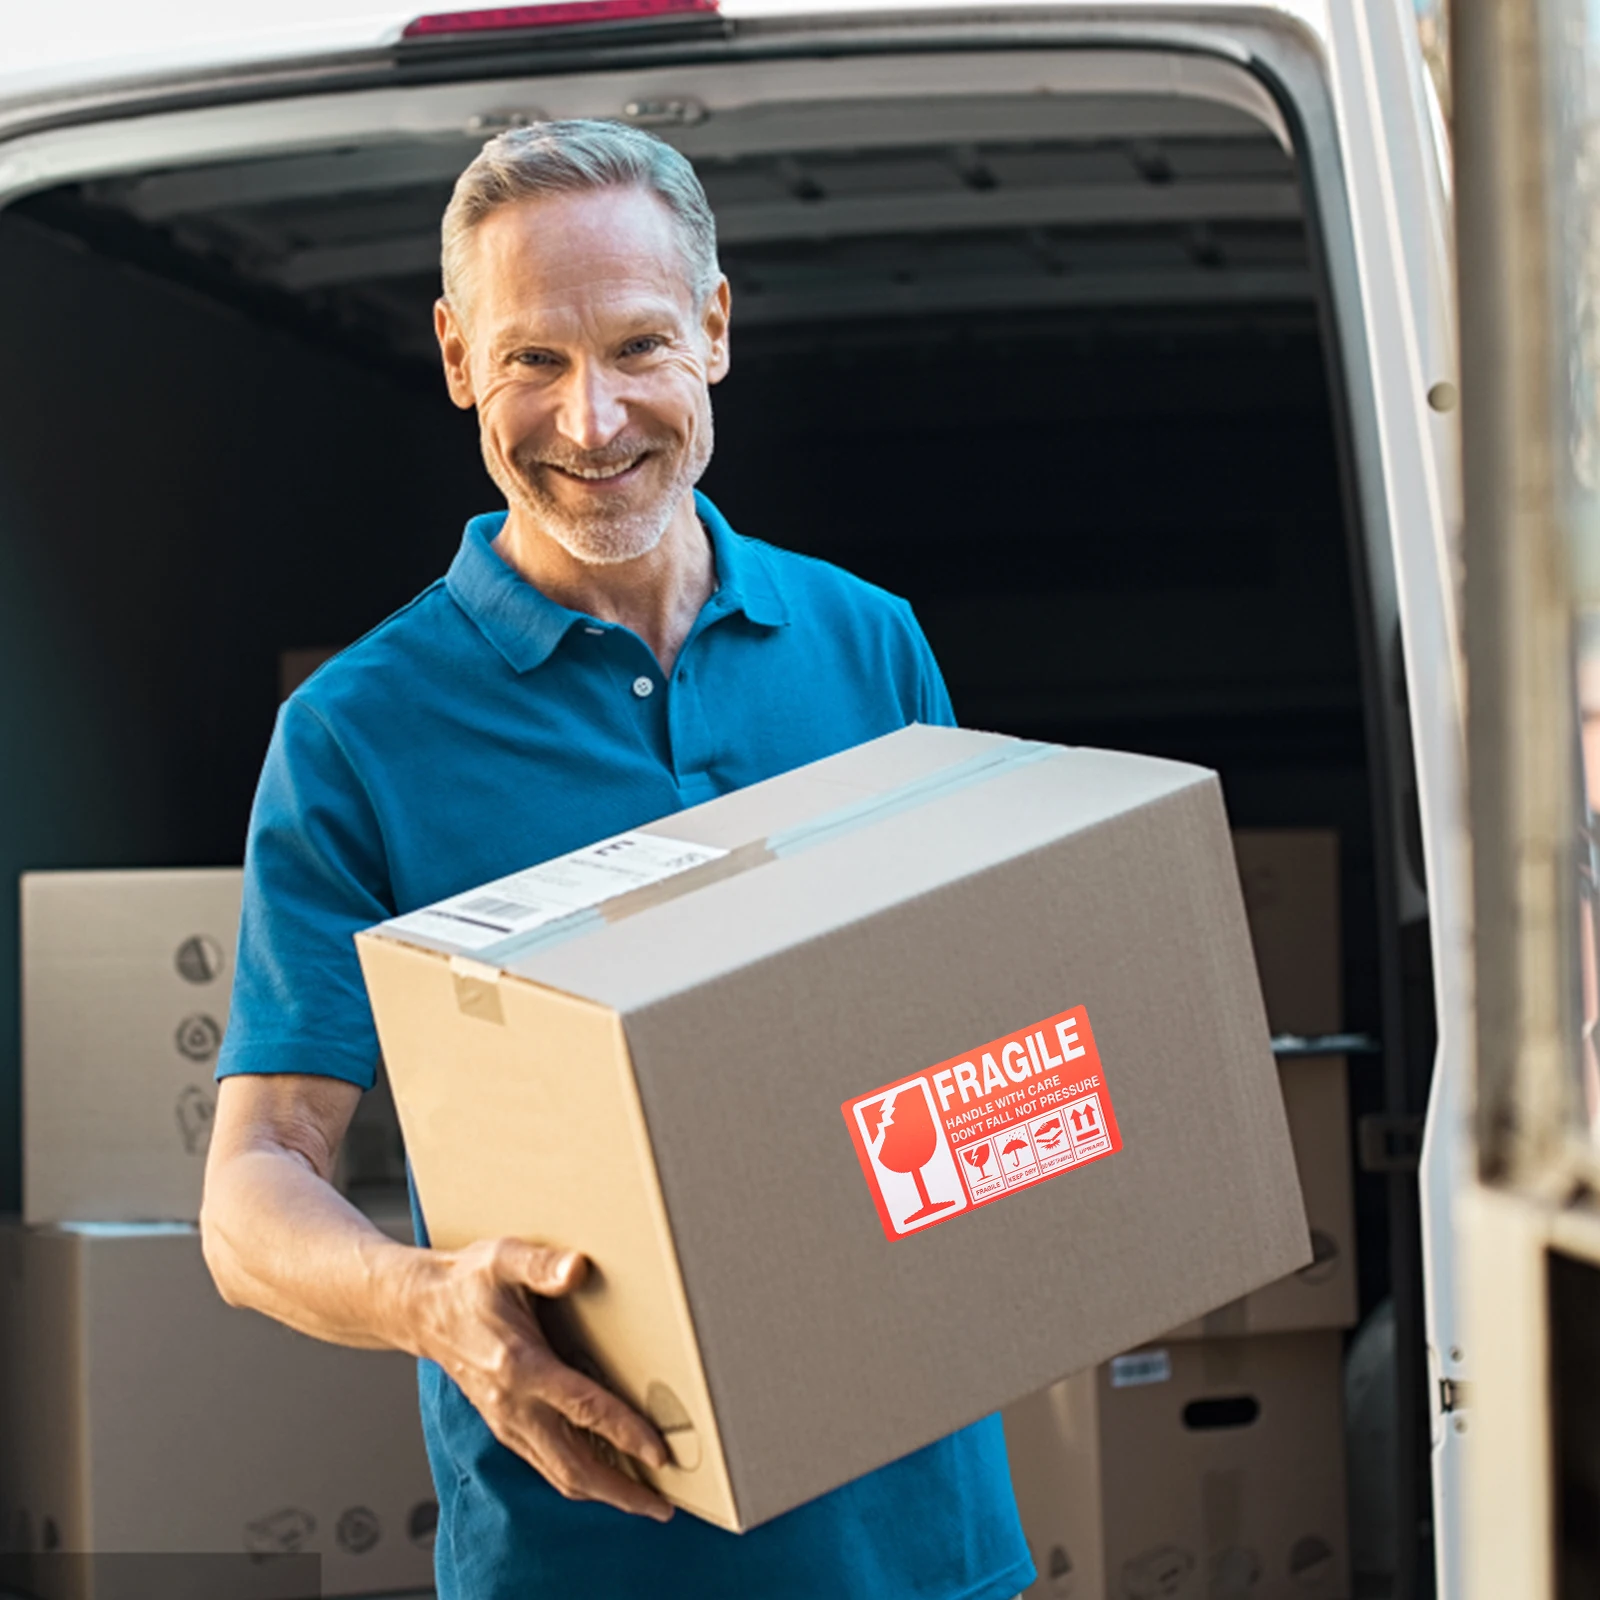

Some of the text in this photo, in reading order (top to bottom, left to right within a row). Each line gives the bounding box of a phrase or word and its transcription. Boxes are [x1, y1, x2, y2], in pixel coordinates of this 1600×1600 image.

[933, 1017, 1086, 1112] FRAGILE
[946, 1075, 1061, 1130] HANDLE WITH CARE
[951, 1075, 1101, 1143] DON'T FALL NOT PRESSURE
[1079, 1141, 1104, 1154] UPWARD
[975, 1181, 1001, 1196] FRAGILE
[1007, 1165, 1037, 1184] KEEP DRY
